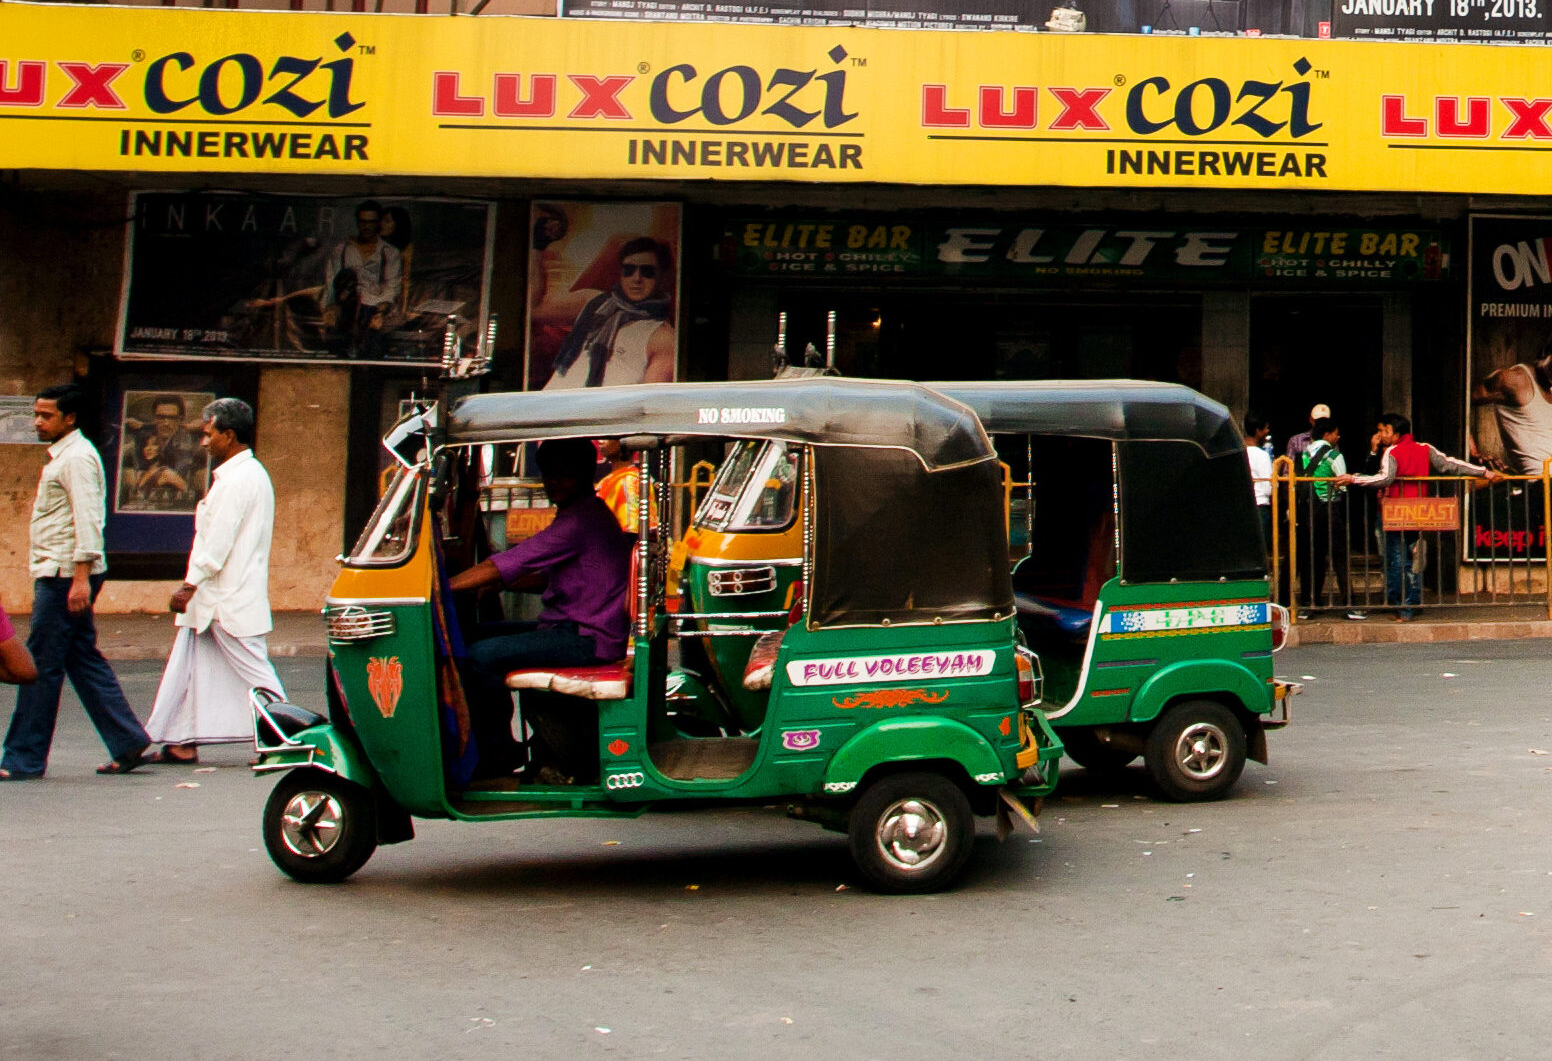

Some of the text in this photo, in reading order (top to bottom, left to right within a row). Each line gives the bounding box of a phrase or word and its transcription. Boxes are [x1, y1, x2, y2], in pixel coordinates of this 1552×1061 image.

[0, 60, 131, 111] UX
[120, 129, 369, 160] INNERWEAR
[627, 139, 864, 170] INNERWEAR
[1107, 149, 1327, 178] INNERWEAR
[742, 223, 913, 250] ELITE BAR
[937, 227, 1240, 268] ELITE
[1262, 230, 1422, 258] ELITE BAR
[776, 251, 820, 261] HOT
[779, 263, 817, 273] ICE
[845, 263, 904, 273] SPICE
[1329, 258, 1397, 269] CHILLY
[1275, 268, 1308, 278] ICE
[1335, 269, 1393, 279] SPICE
[1481, 302, 1540, 318] PREMIUM
[698, 407, 785, 424] NO SMOKING
[1384, 504, 1456, 521] CONCAST
[1476, 525, 1533, 552] keep
[804, 661, 859, 684] FULL
